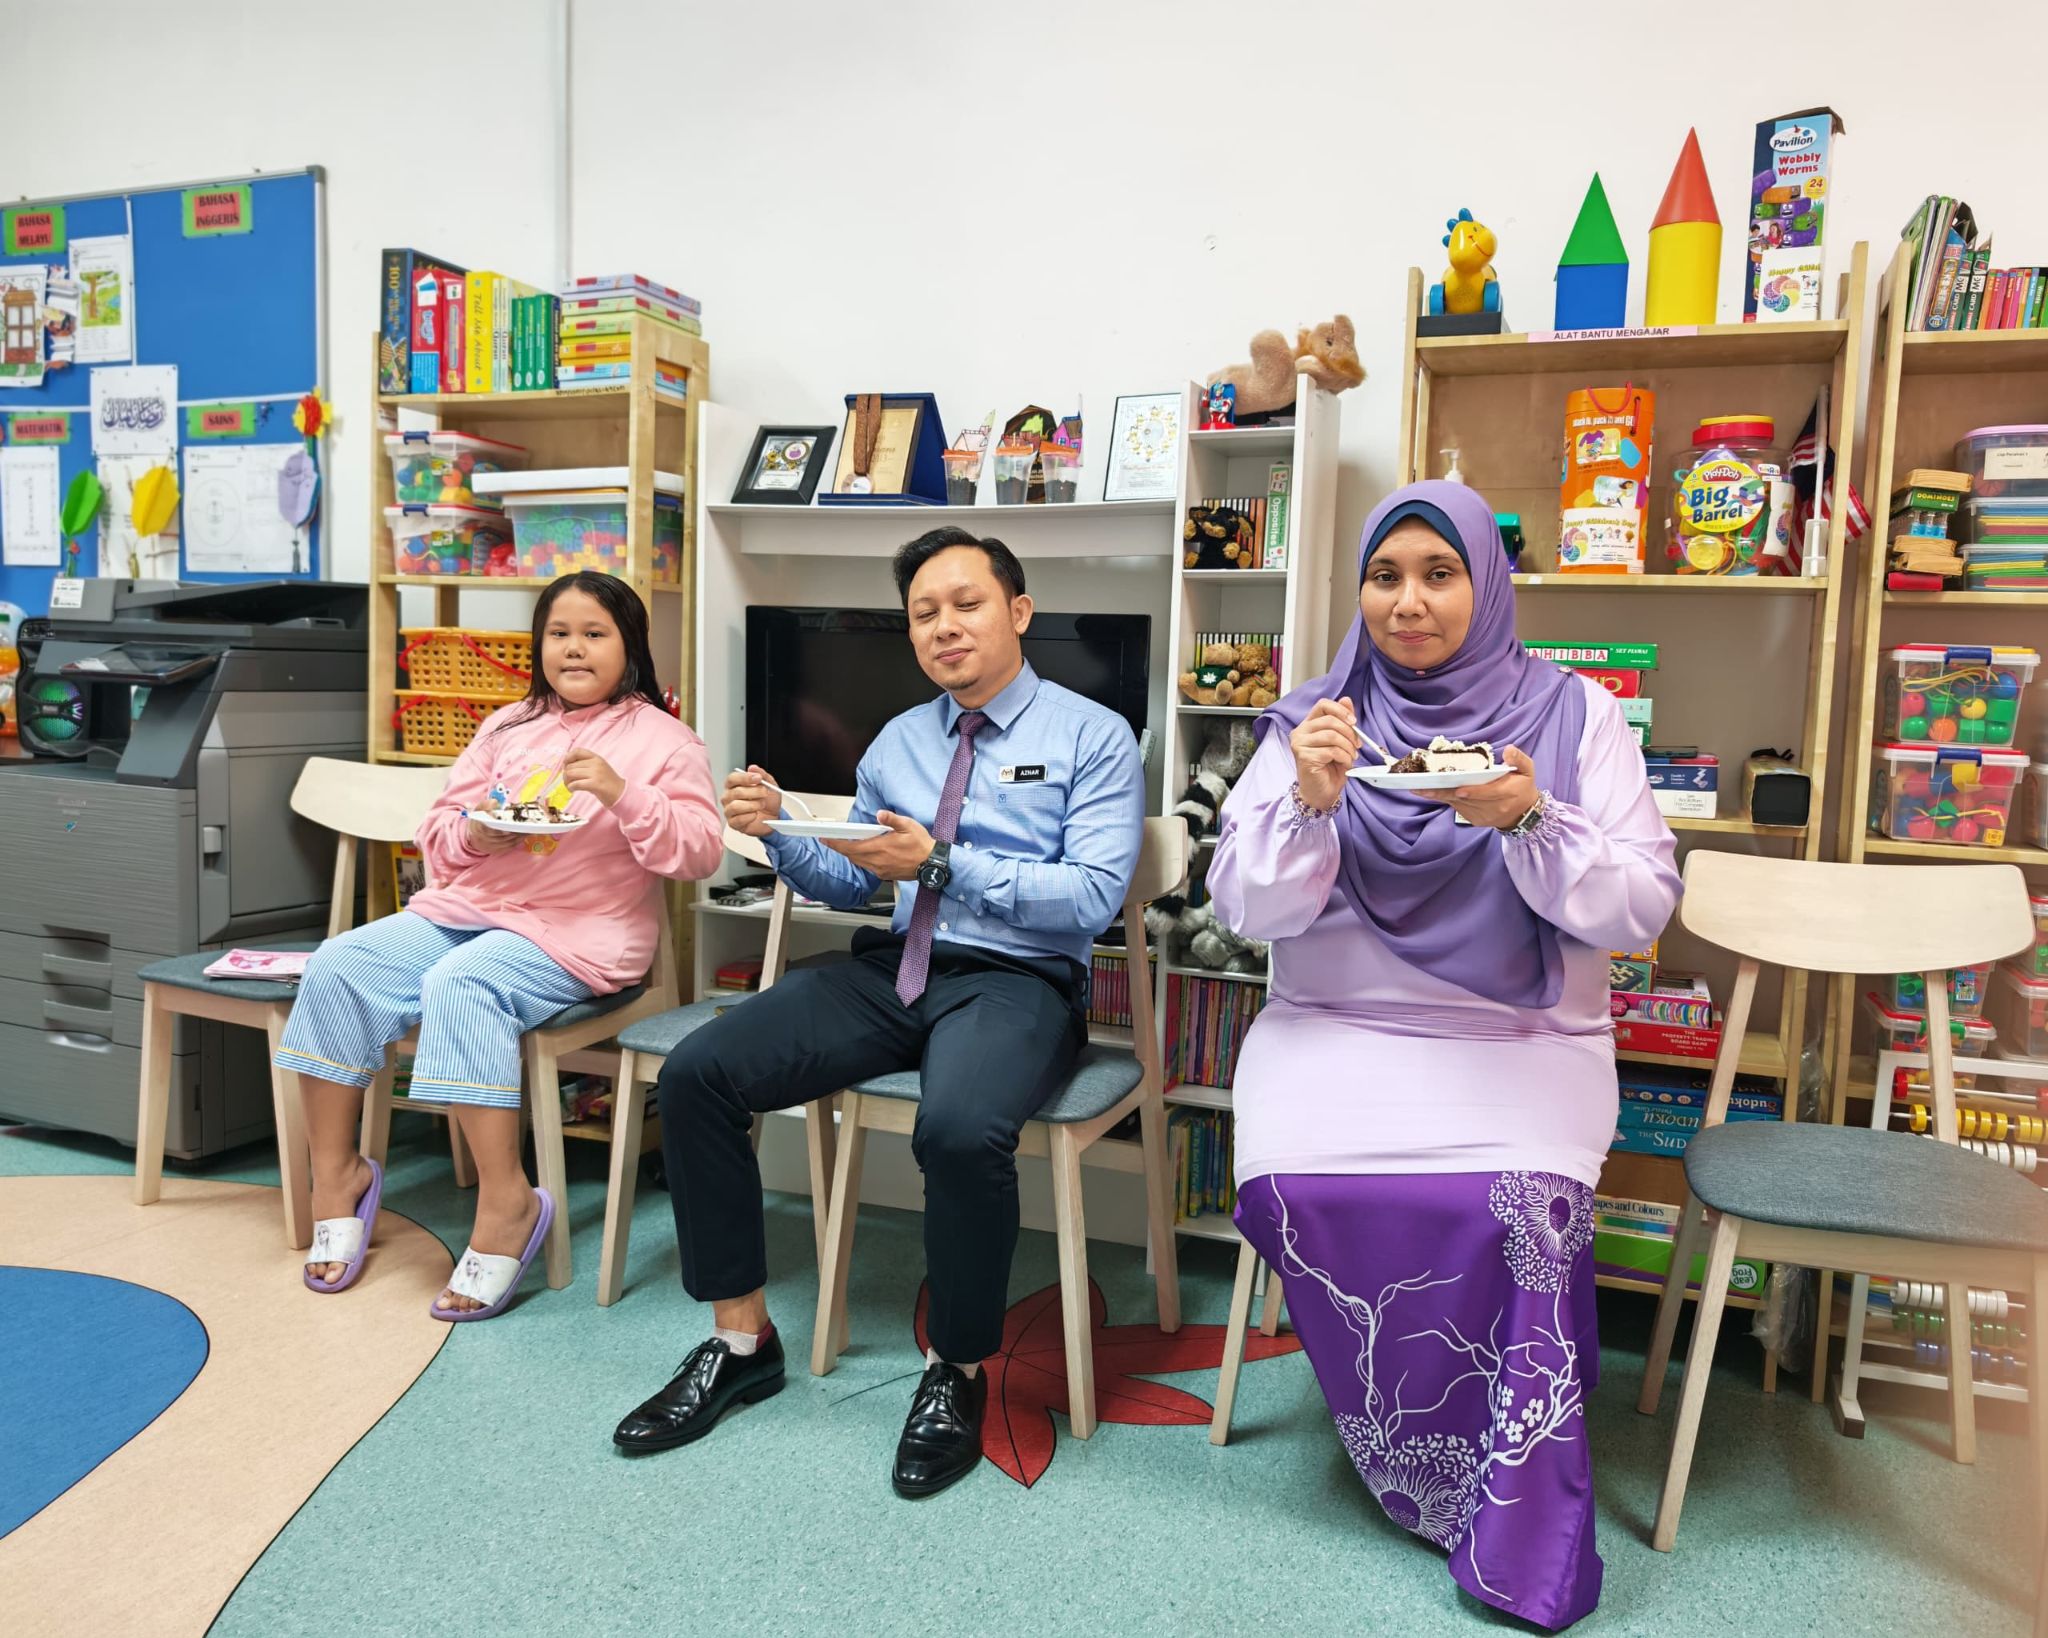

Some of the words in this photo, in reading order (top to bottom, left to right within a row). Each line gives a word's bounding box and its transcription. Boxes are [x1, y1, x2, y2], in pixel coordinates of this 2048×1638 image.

[1773, 135, 1814, 149] Pavilion
[1779, 153, 1822, 165] Wobbly
[1778, 164, 1819, 176] Worms
[1809, 178, 1824, 188] 24
[198, 193, 236, 208] BAHASA
[17, 214, 51, 228] BAHASA
[196, 213, 240, 228] INGGERIS
[473, 293, 483, 315] Tell
[1554, 329, 1580, 340] ALAT
[1580, 328, 1613, 339] BANTU
[1615, 327, 1670, 338] MENGAJAR
[473, 339, 483, 371] About
[207, 415, 235, 427] SAINS
[16, 422, 63, 436] MATEMATIK
[1691, 486, 1730, 508] Big
[1693, 504, 1743, 524] Barrel
[1270, 496, 1281, 547] Opposites
[1529, 647, 1608, 661] AHIBBA
[1614, 1200, 1631, 1212] and
[1632, 1202, 1665, 1217] Colours
[1733, 1276, 1755, 1285] Leap
